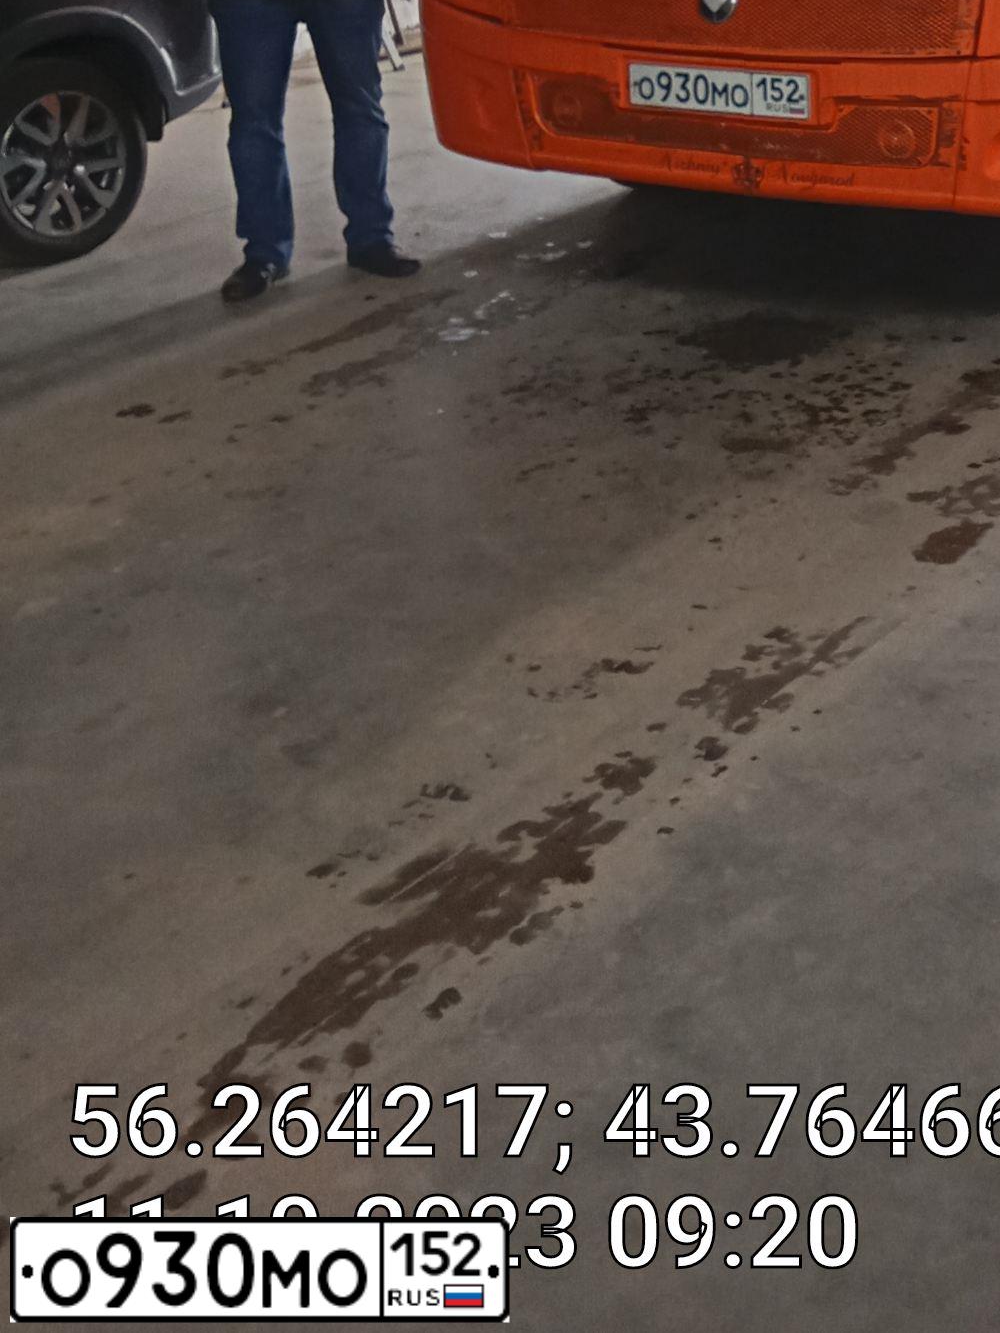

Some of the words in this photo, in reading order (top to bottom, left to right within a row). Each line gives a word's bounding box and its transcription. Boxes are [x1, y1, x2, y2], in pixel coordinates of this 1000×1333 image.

[638, 71, 749, 109] О930МО
[756, 77, 801, 104] 152
[766, 104, 789, 114] RUS
